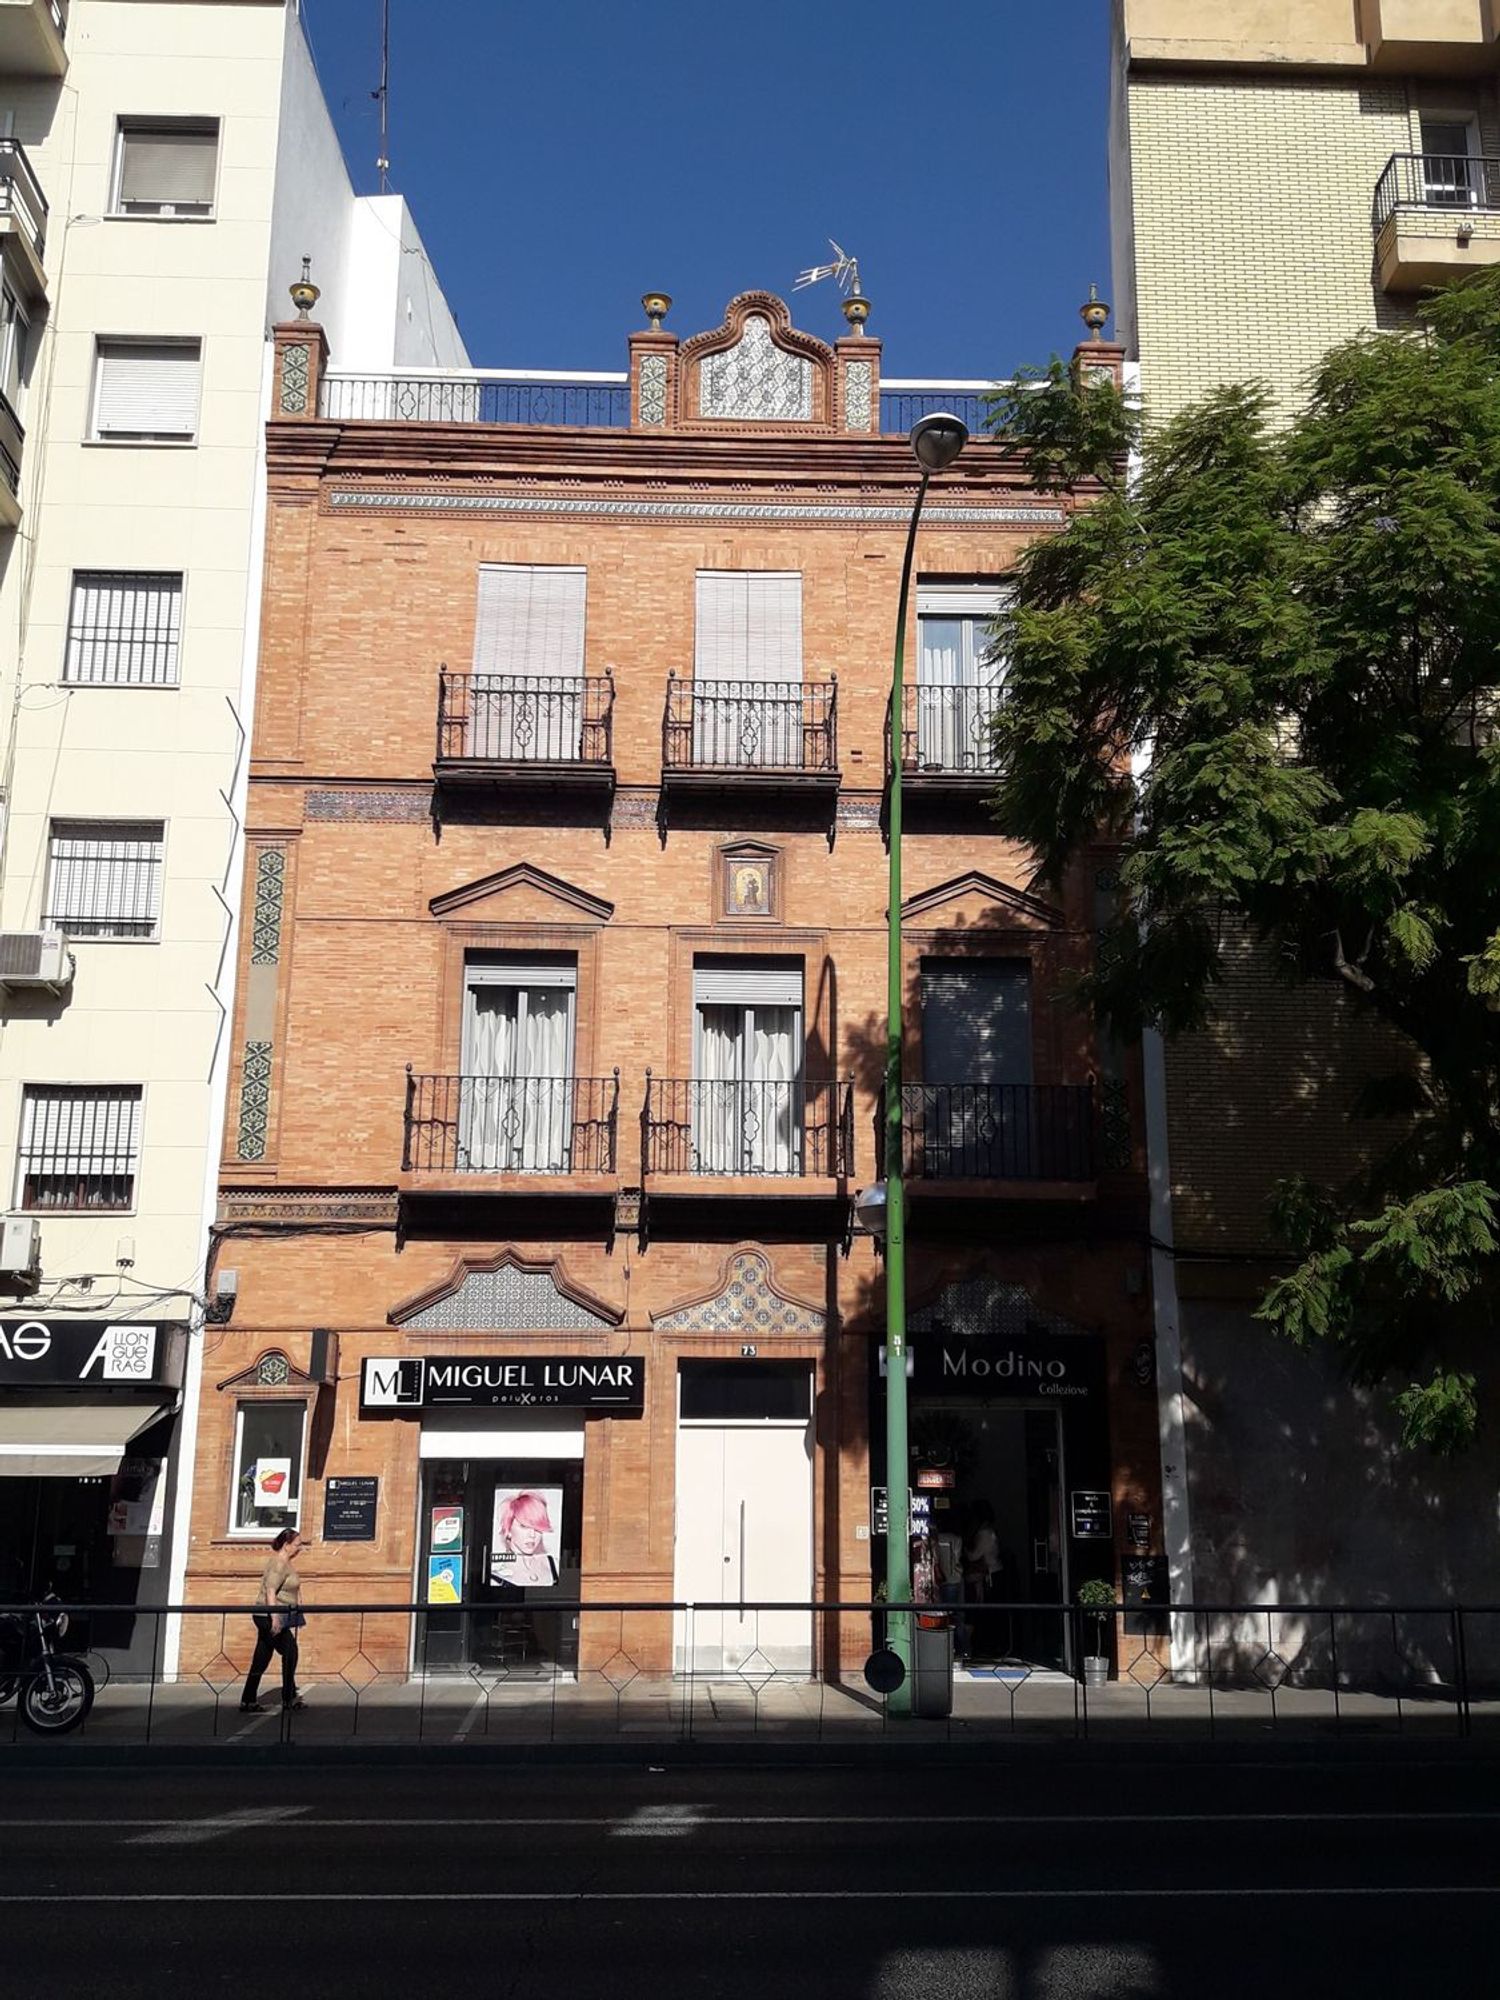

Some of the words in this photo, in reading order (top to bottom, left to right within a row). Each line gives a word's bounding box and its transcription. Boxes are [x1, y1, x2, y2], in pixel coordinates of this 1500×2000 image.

[742, 1345, 756, 1356] 73
[111, 1359, 147, 1373] RAS
[428, 1365, 534, 1387] MIGUEL
[544, 1365, 633, 1387] LUNAR
